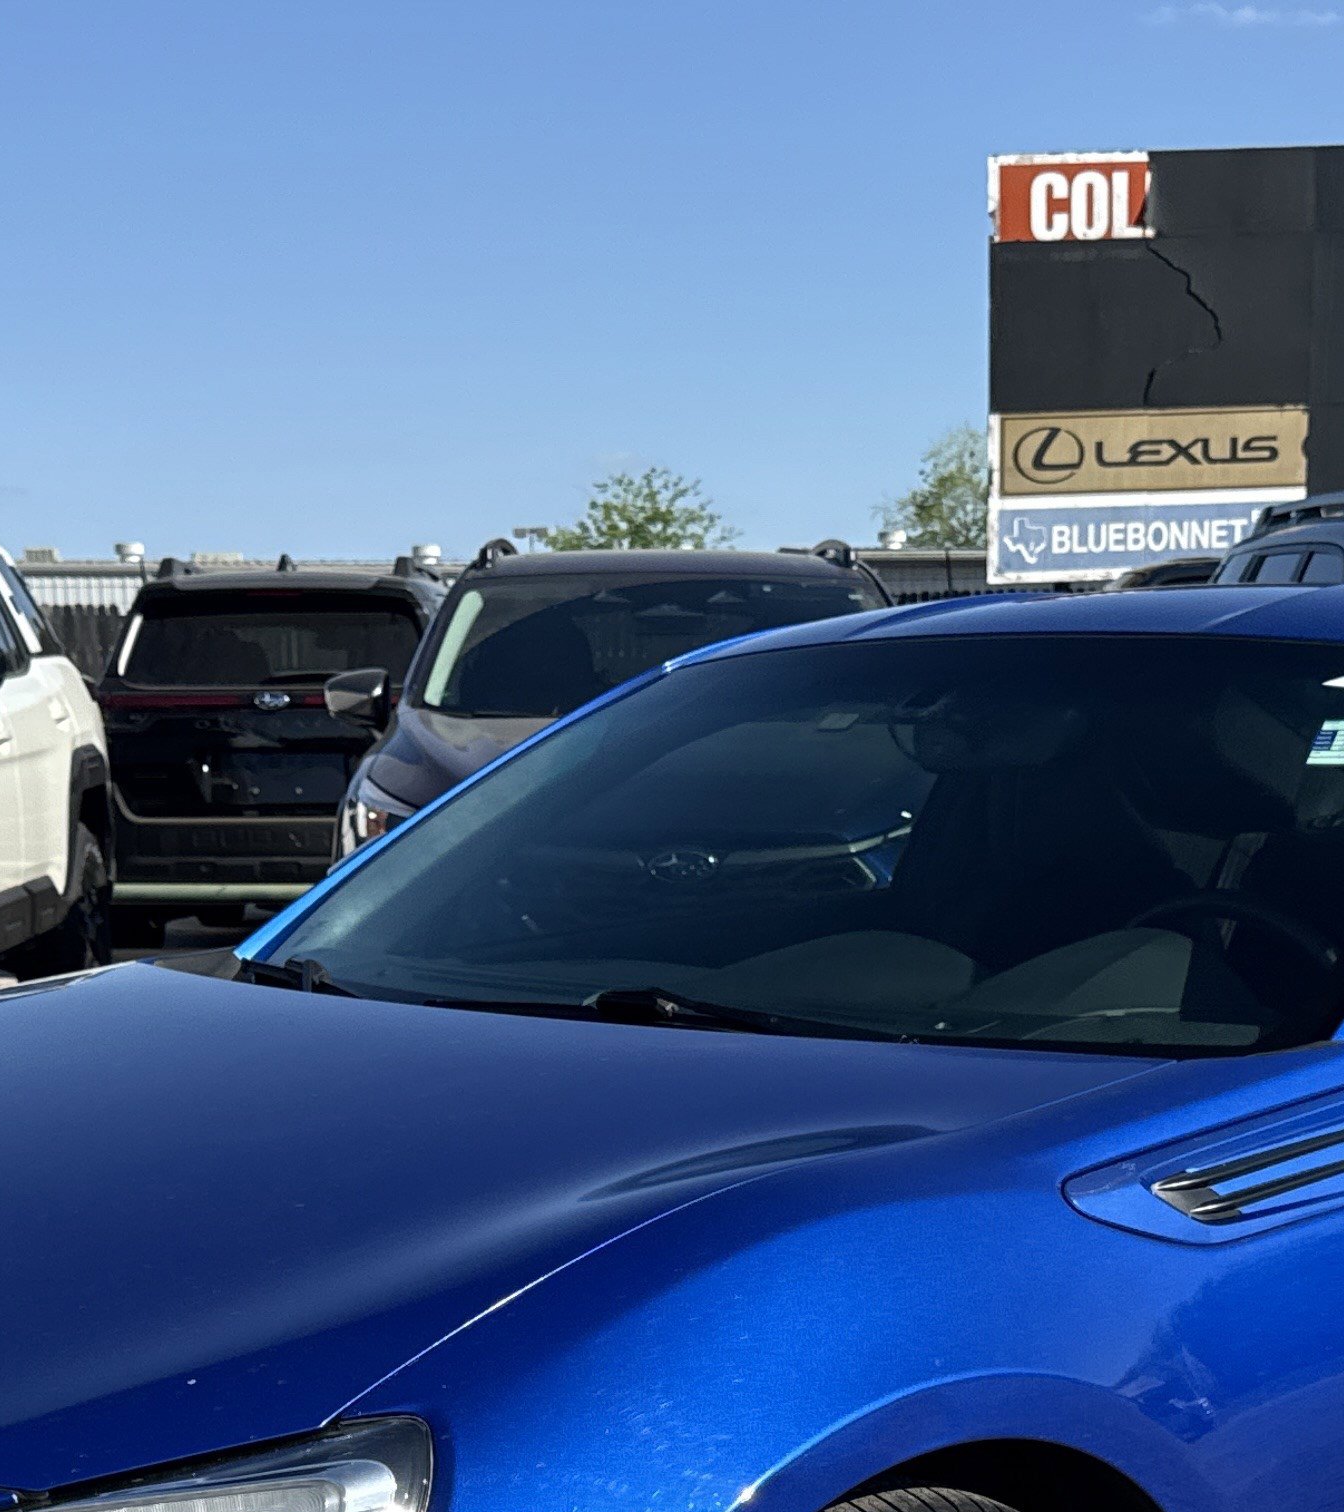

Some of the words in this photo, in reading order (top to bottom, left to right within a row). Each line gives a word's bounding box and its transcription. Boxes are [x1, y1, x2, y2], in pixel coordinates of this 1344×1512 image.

[1030, 168, 1155, 241] COL
[1095, 435, 1279, 468] LEXUS
[1051, 518, 1248, 555] BLUEBONNET
